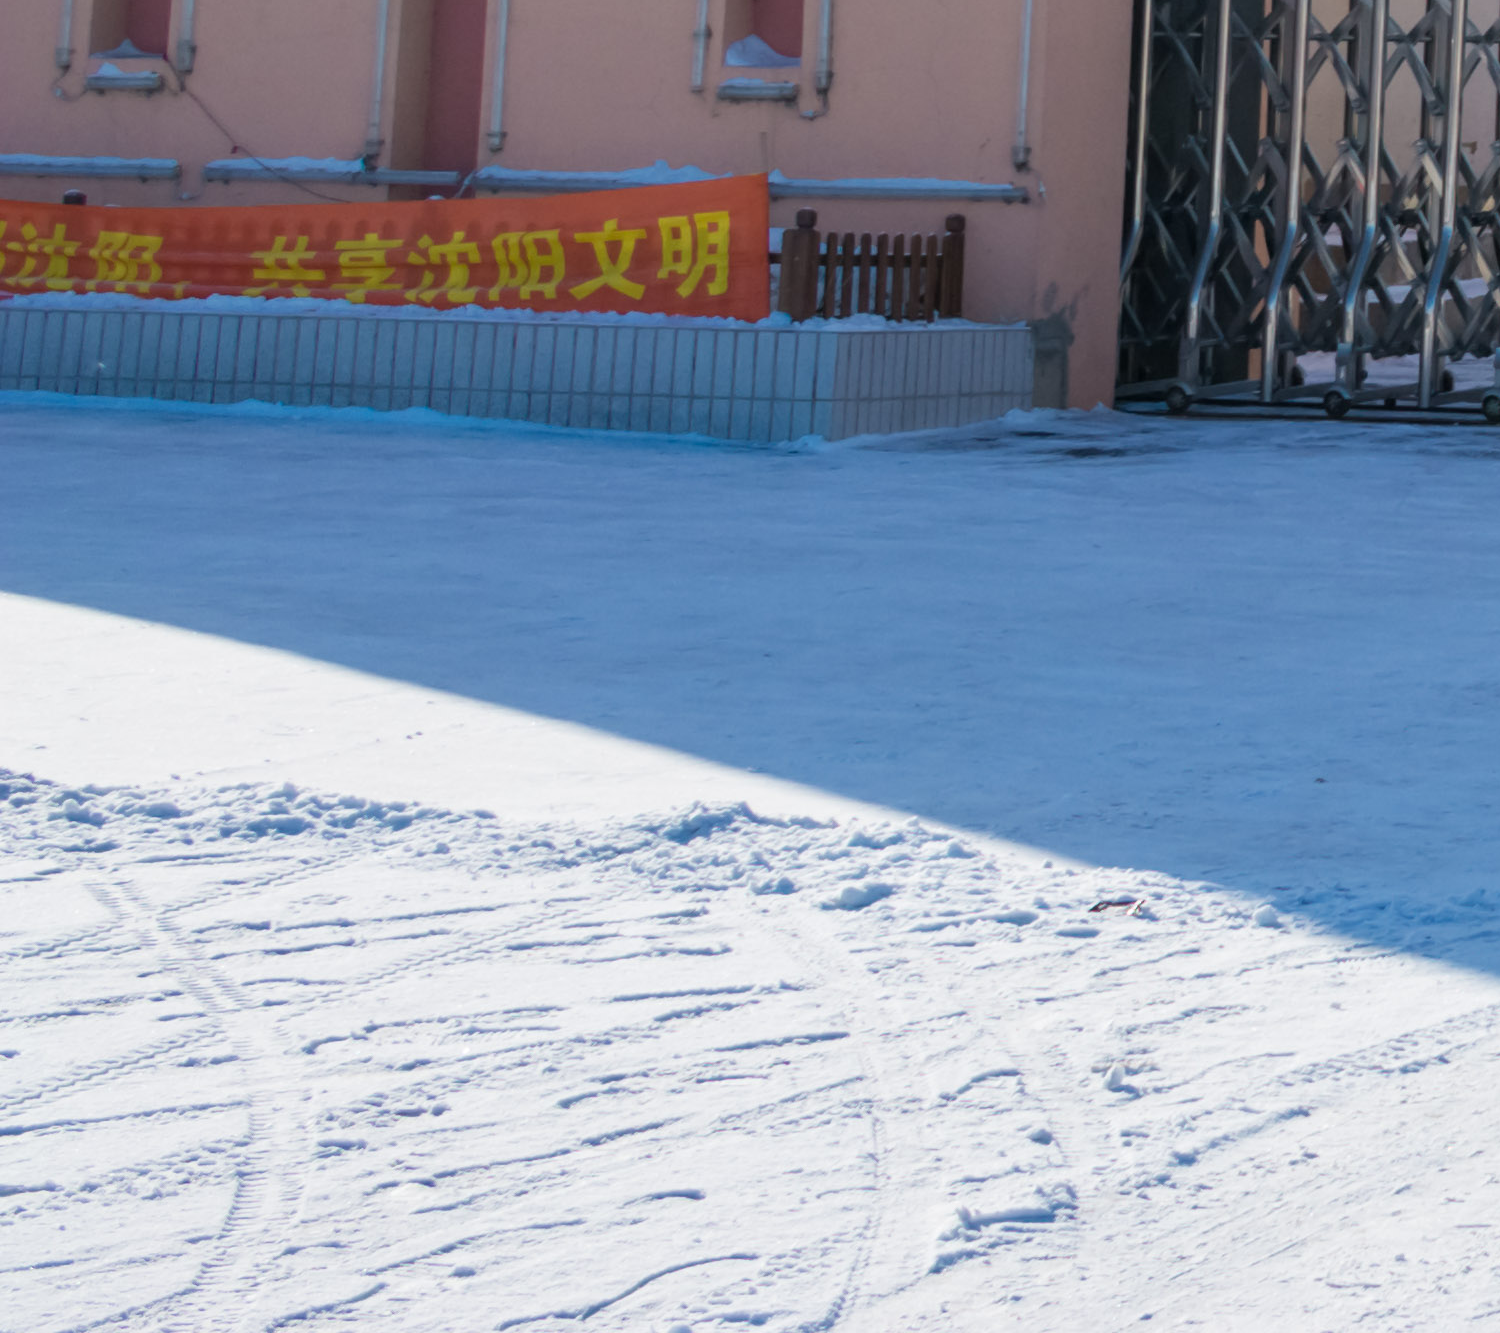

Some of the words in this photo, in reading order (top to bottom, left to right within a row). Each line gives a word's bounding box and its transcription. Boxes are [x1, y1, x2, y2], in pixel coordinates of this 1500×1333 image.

[243, 210, 731, 304] 共享沈阳文明
